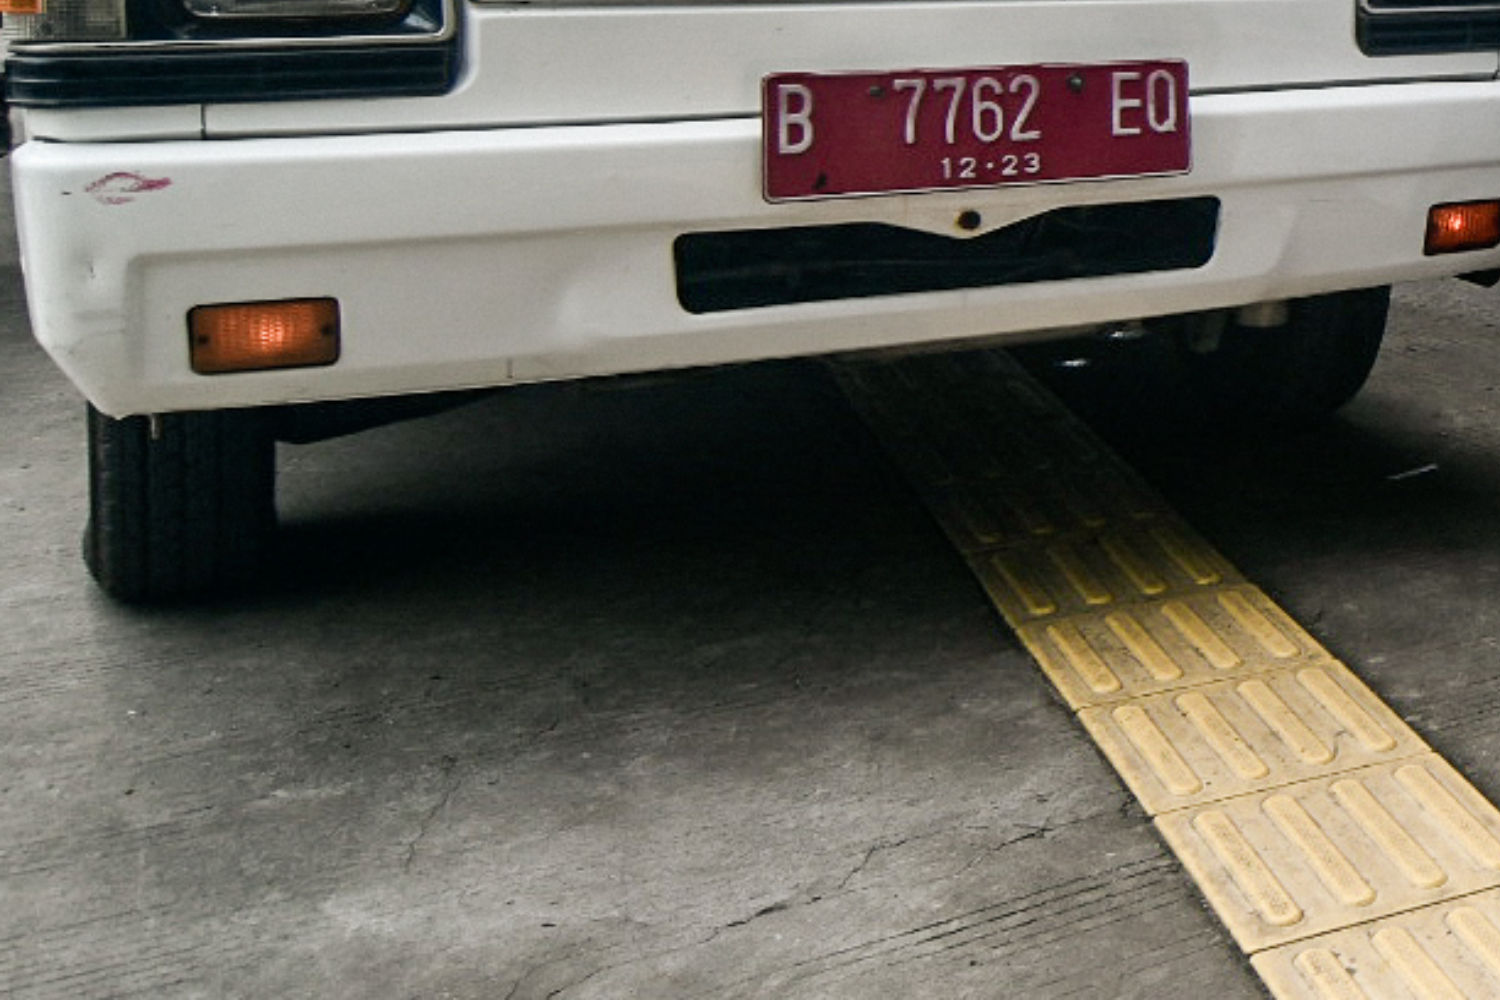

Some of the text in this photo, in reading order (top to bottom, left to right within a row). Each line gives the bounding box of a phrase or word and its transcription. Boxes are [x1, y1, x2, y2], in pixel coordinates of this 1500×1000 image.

[777, 69, 1178, 154] B 7762 EQ
